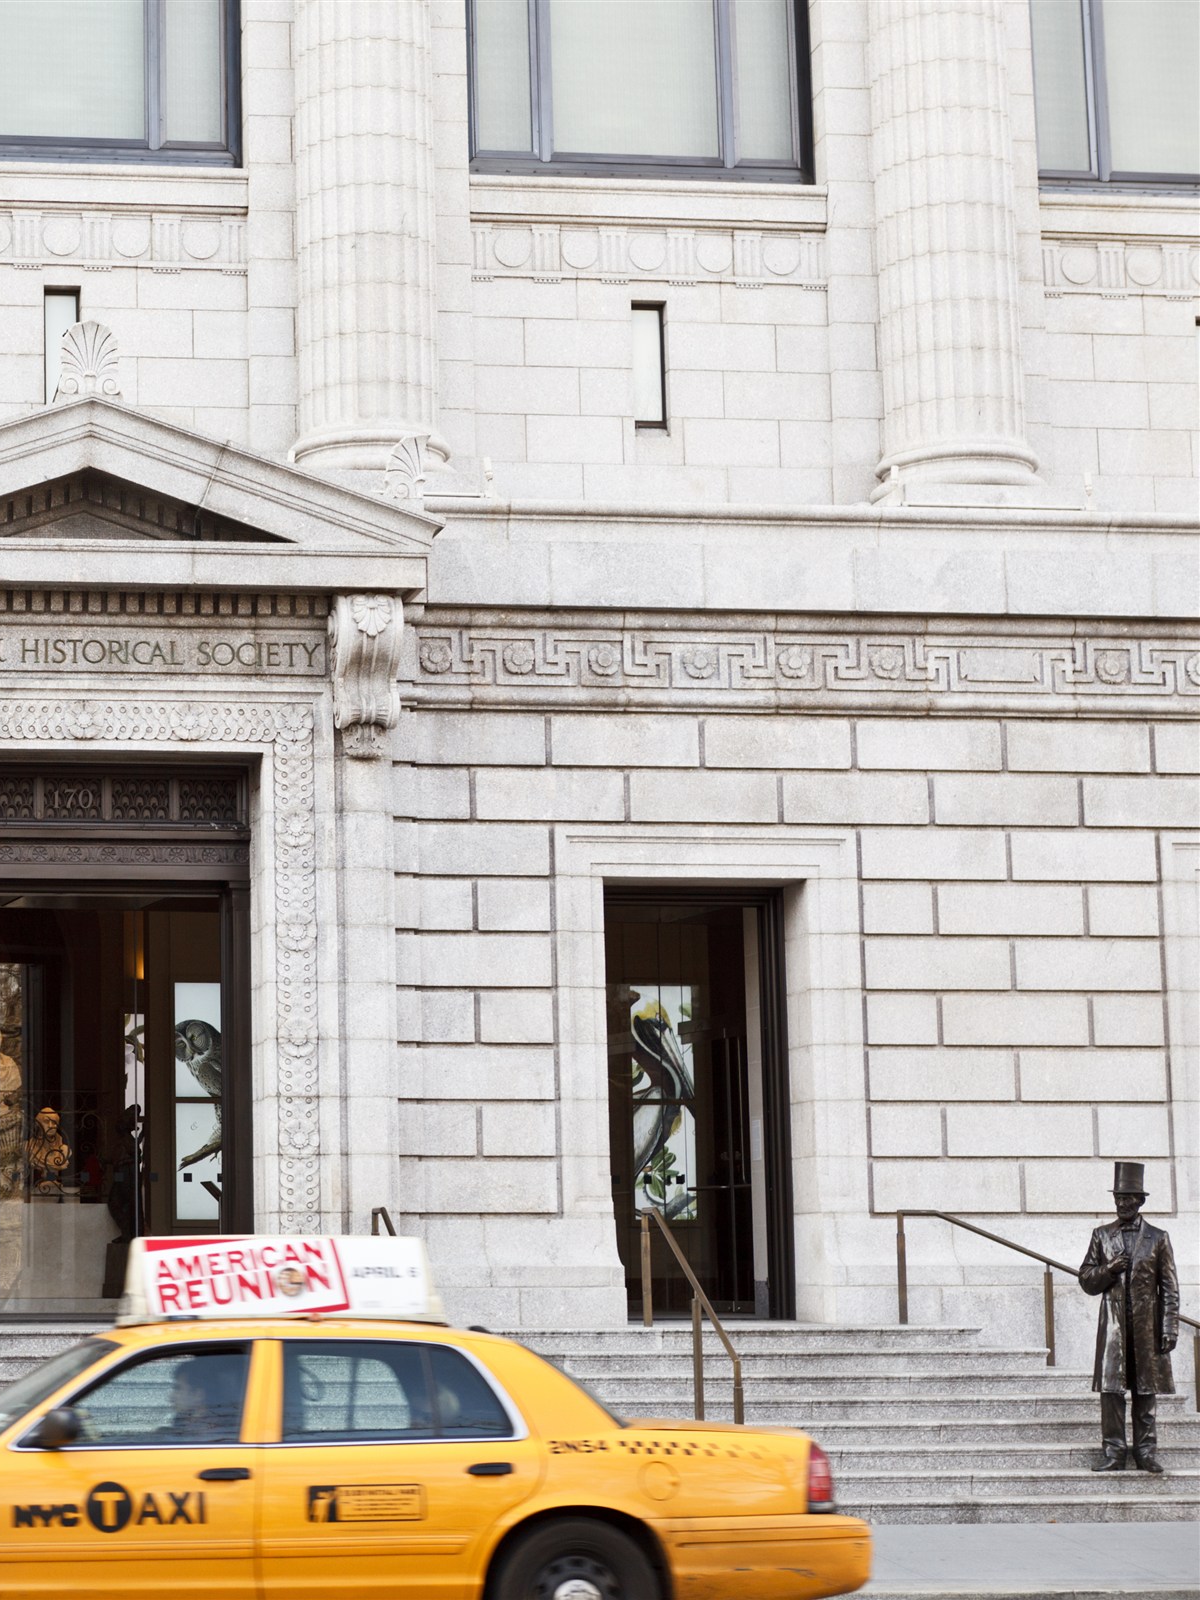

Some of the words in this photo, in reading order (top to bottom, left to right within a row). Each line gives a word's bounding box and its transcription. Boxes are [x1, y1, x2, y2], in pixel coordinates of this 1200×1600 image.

[21, 638, 184, 665] HISTORICAL
[197, 641, 321, 667] SOCIETY
[53, 788, 93, 809] 170
[157, 1241, 324, 1279] AMERICAN
[351, 1266, 403, 1279] APRIL
[13, 1504, 80, 1528] NYC
[88, 1485, 208, 1530] TAXI
